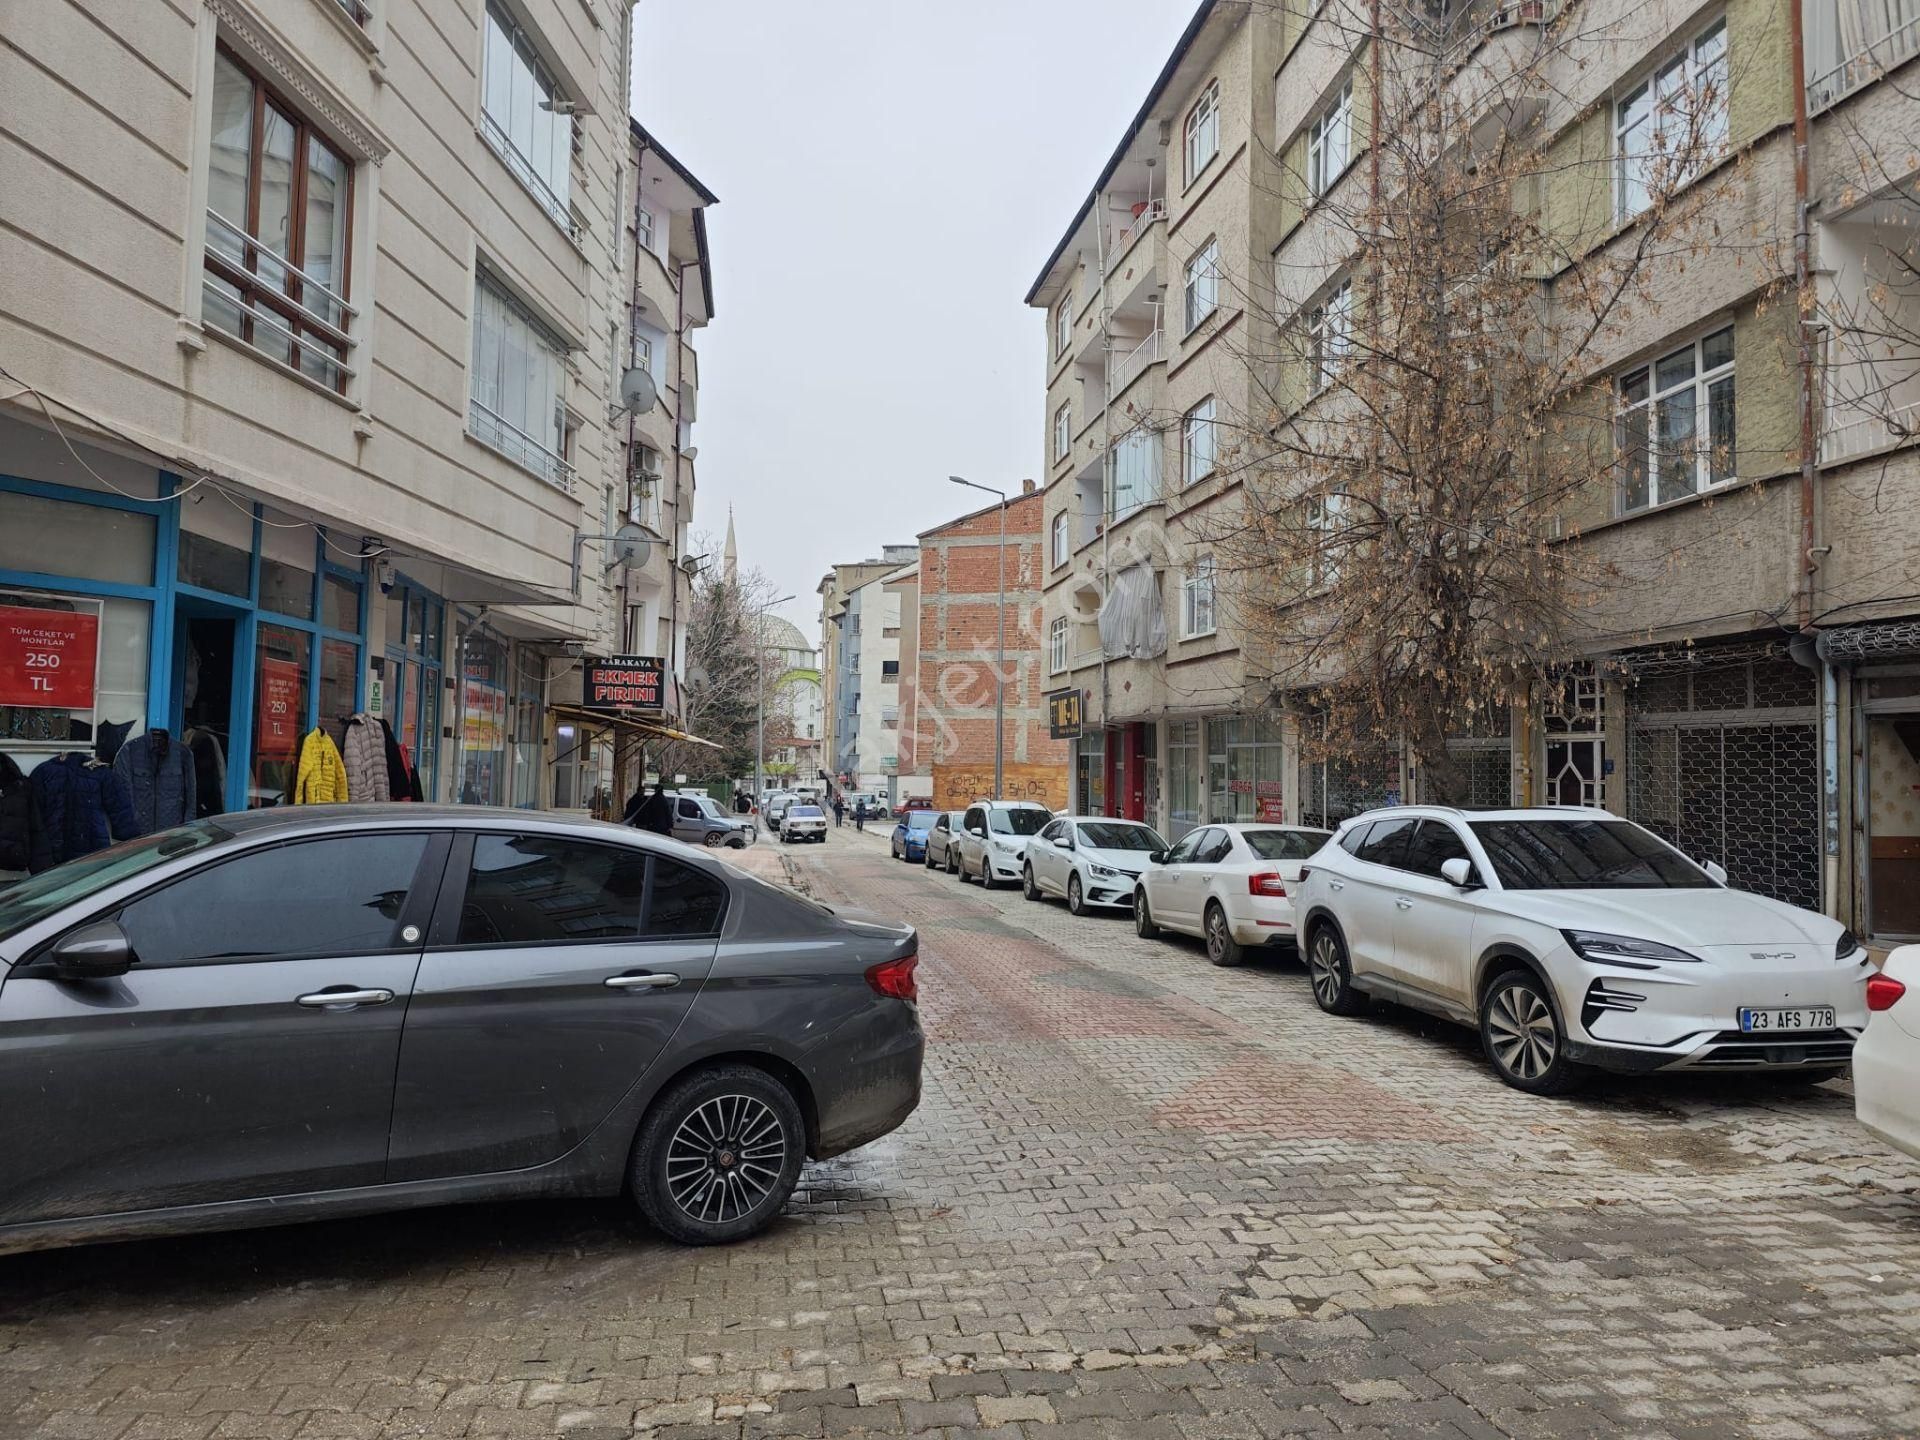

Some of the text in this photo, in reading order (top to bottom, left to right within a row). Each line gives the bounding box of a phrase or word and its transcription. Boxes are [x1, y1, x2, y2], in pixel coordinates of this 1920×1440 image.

[10, 626, 76, 640] TÜM CEKET VE
[21, 636, 65, 647] MONTLAR
[25, 652, 60, 668] 250
[601, 658, 651, 667] KARAKAYA
[30, 676, 54, 691] TL
[592, 669, 659, 686] EKMEK
[595, 685, 656, 702] FIRINI
[271, 701, 287, 713] 250
[272, 721, 283, 735] TL
[1750, 952, 1796, 960] BYD
[1752, 1009, 1833, 1029] 23 AFS 778
